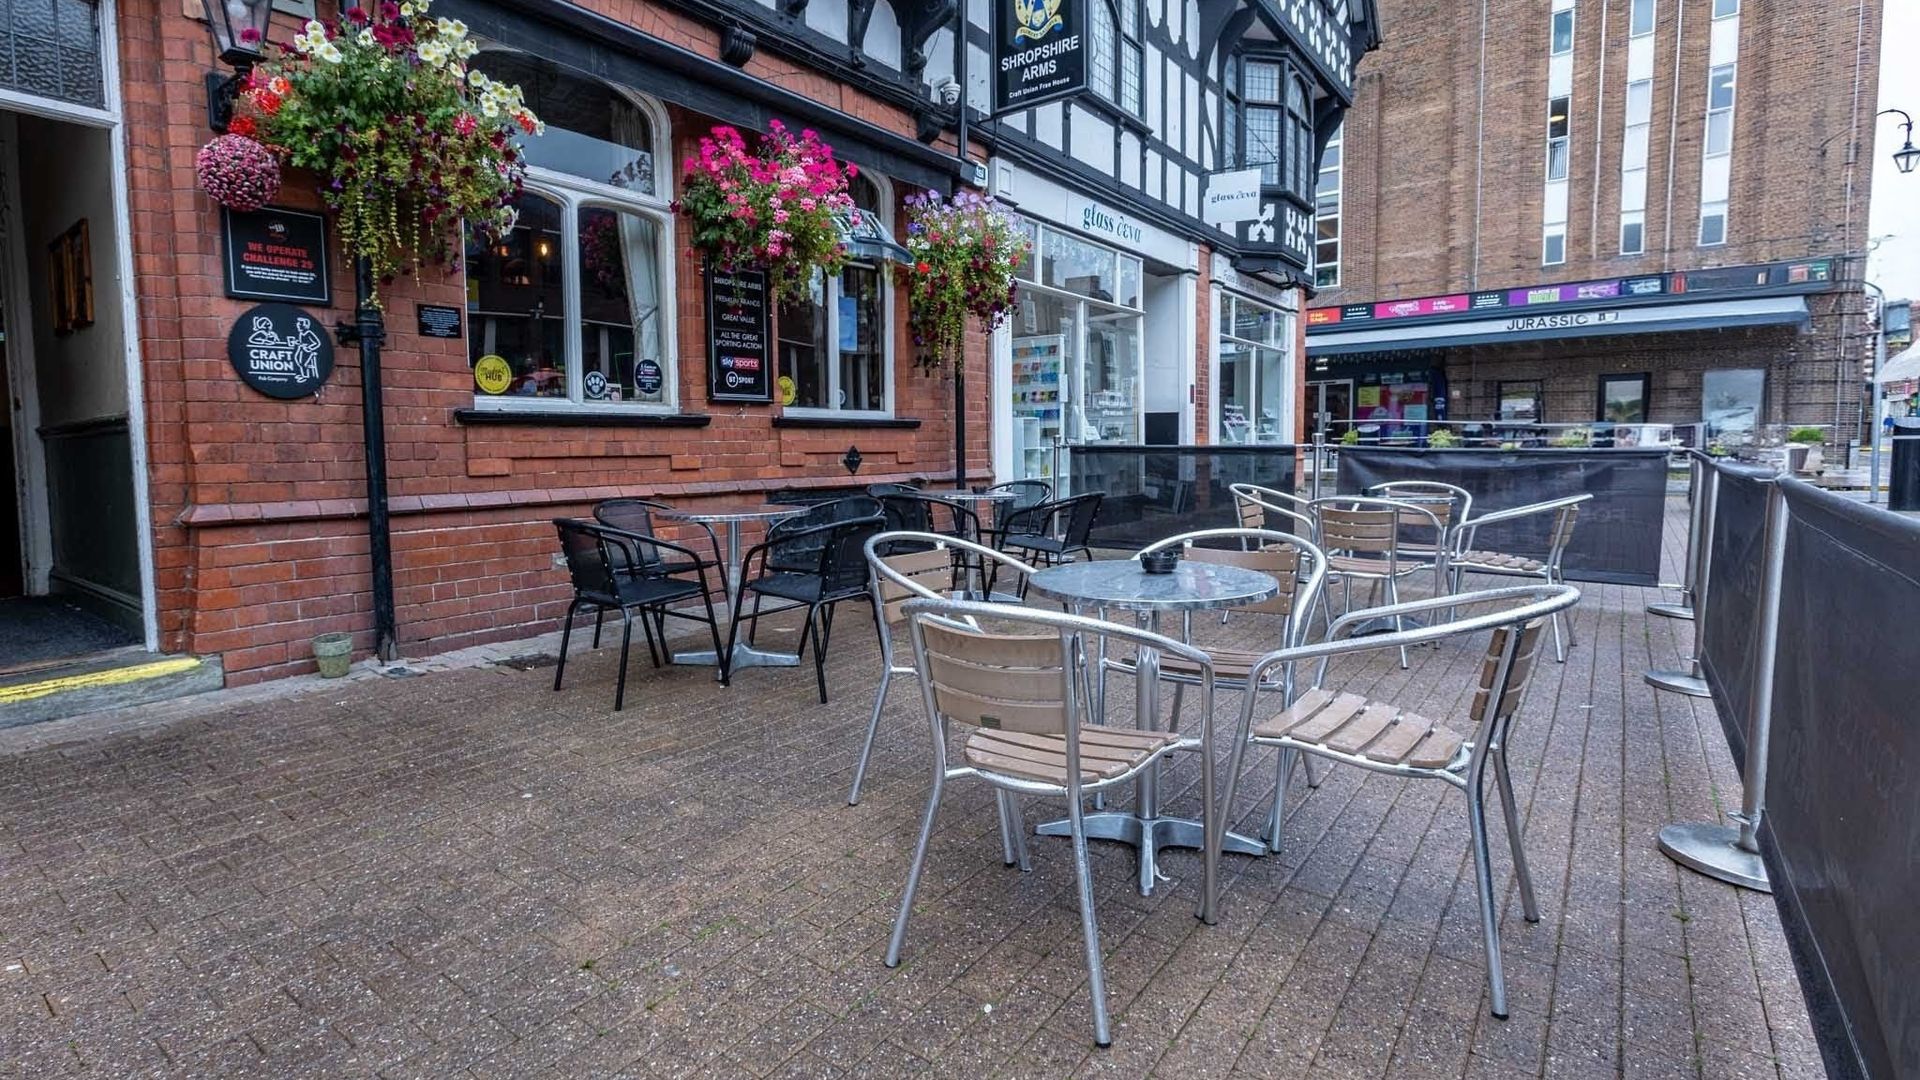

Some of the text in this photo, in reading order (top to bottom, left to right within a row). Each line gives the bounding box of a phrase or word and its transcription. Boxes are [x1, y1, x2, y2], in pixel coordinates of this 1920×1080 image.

[1001, 35, 1079, 71] SHROPSHIRE
[1022, 60, 1057, 82] ARMS
[1009, 89, 1021, 98] Craft
[1023, 86, 1039, 95] Union
[1052, 77, 1070, 86] House
[1211, 193, 1234, 203] glass
[1083, 204, 1114, 233] glass
[248, 242, 308, 258] WE OPERATE
[243, 252, 298, 267] CHALLENGE
[721, 313, 739, 322] GREAT
[1506, 313, 1589, 331] JURASSIC
[720, 331, 759, 341] ALL THE GREAT
[715, 339, 762, 350] SPORTING ACTION
[249, 349, 293, 361] CRAFT
[250, 360, 294, 371] UNION
[722, 357, 759, 369] sky sports
